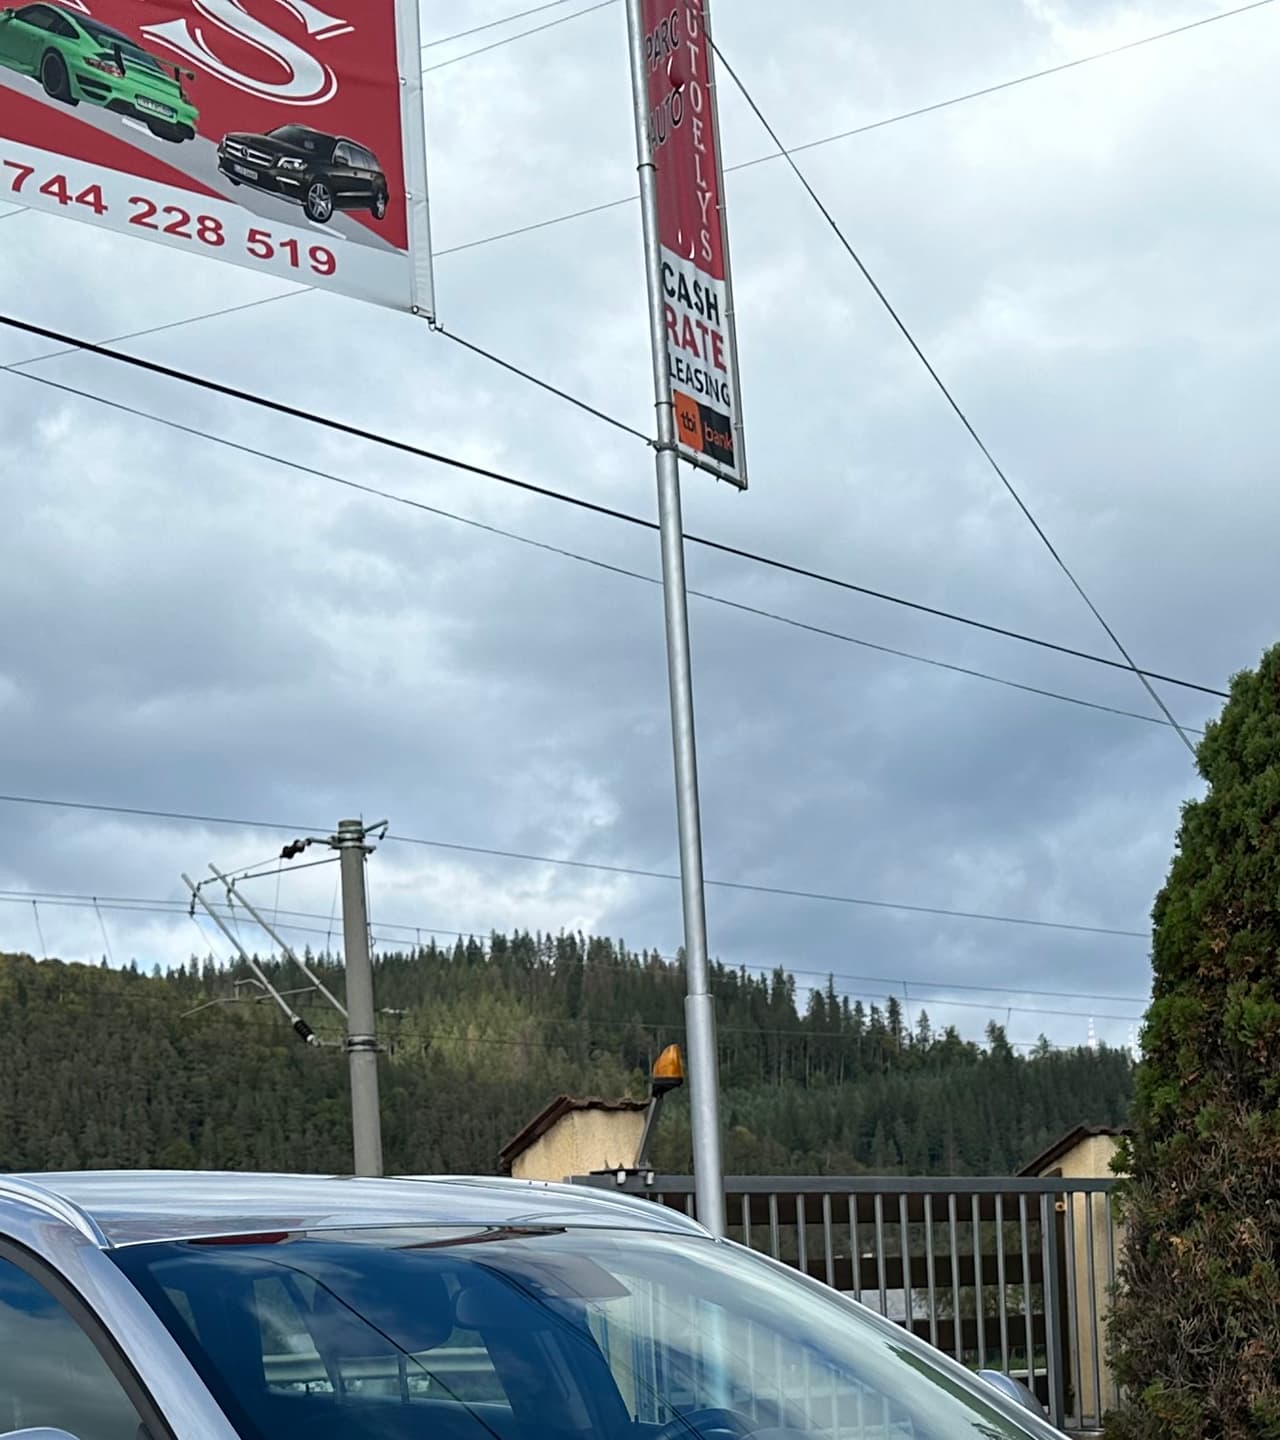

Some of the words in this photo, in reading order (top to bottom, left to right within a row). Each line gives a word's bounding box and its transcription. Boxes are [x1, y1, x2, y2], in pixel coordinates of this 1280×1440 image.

[684, 0, 713, 262] UTOELYS
[128, 196, 226, 247] 228
[245, 227, 337, 276] 519
[661, 260, 721, 327] CASH
[664, 301, 727, 374] RATE
[669, 352, 731, 408] LEASING
[704, 420, 733, 449] bank
